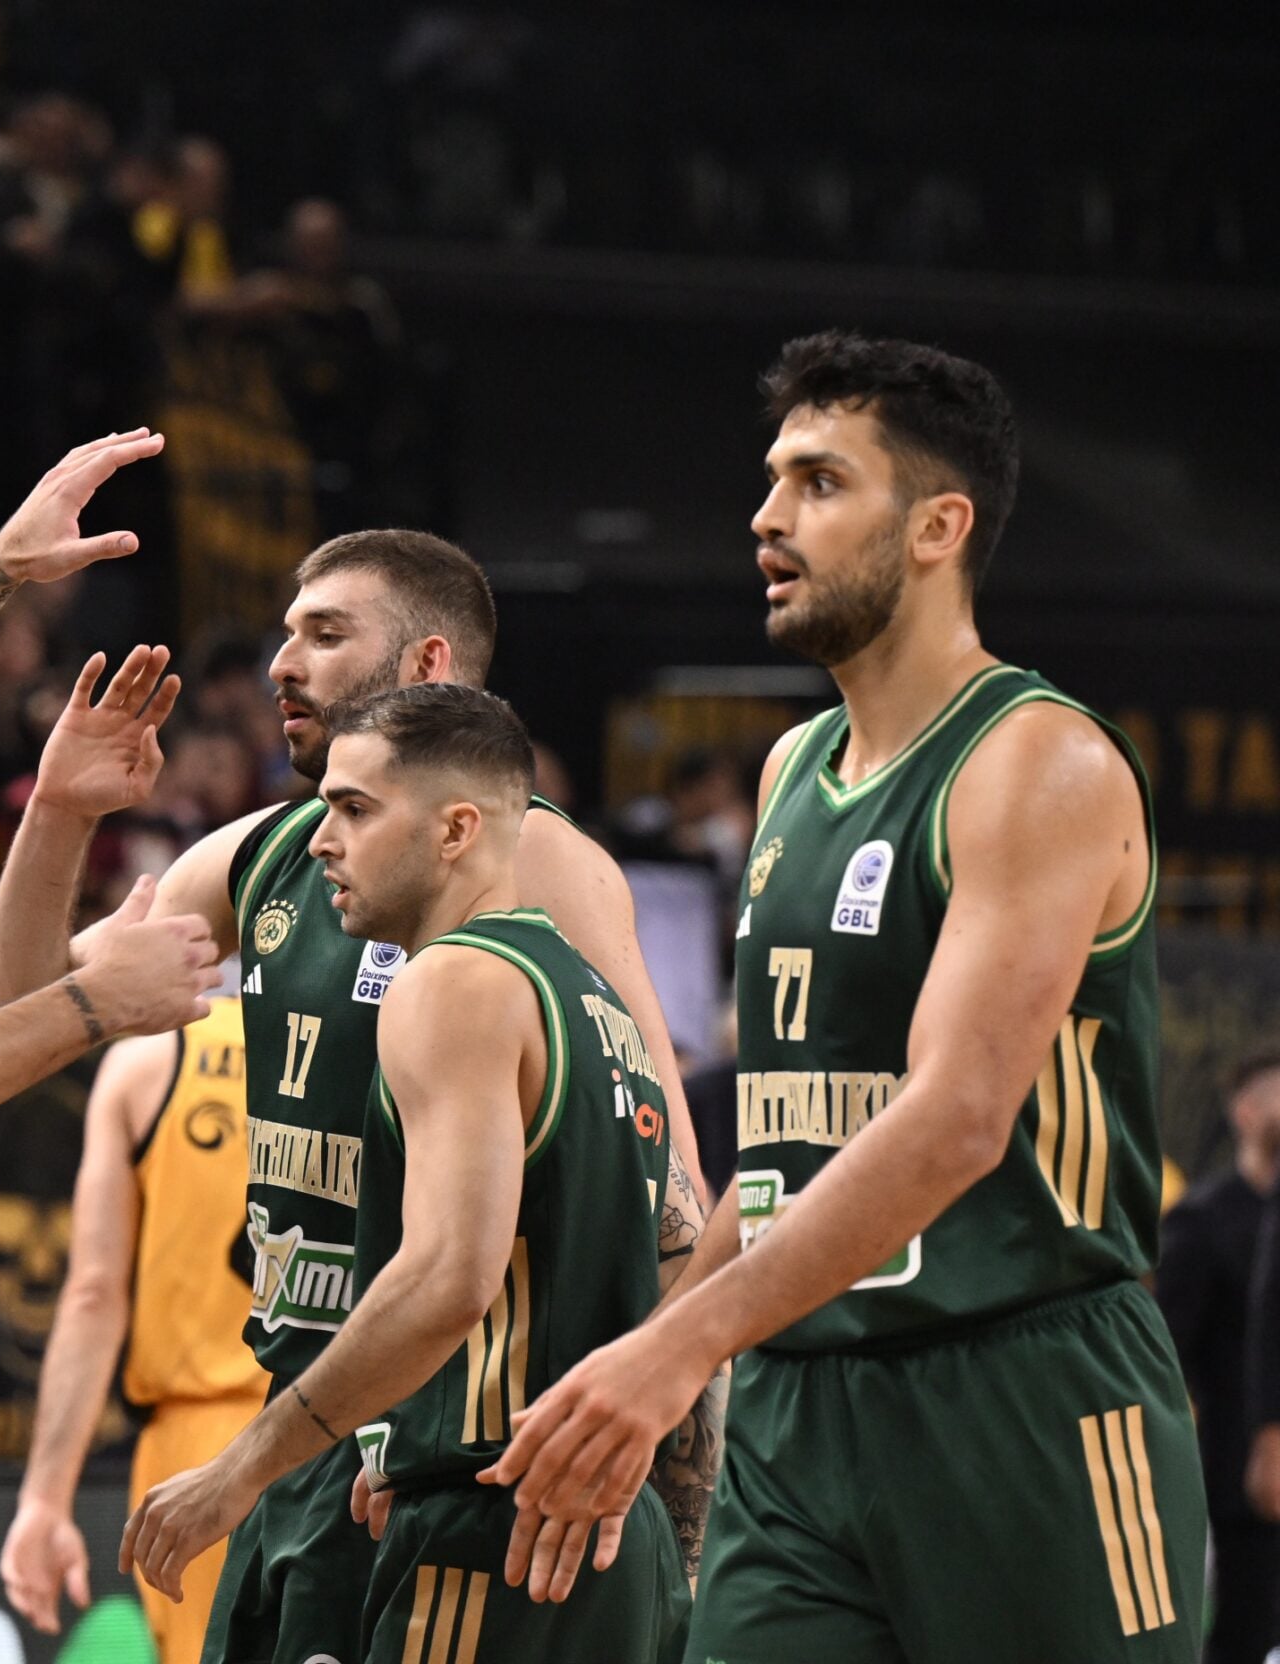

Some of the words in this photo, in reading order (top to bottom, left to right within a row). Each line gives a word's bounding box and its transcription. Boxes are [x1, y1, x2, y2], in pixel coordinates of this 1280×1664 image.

[837, 908, 873, 929] GBL
[359, 967, 395, 983] Stoixima
[768, 947, 813, 1041] 77
[277, 1011, 322, 1100] 17
